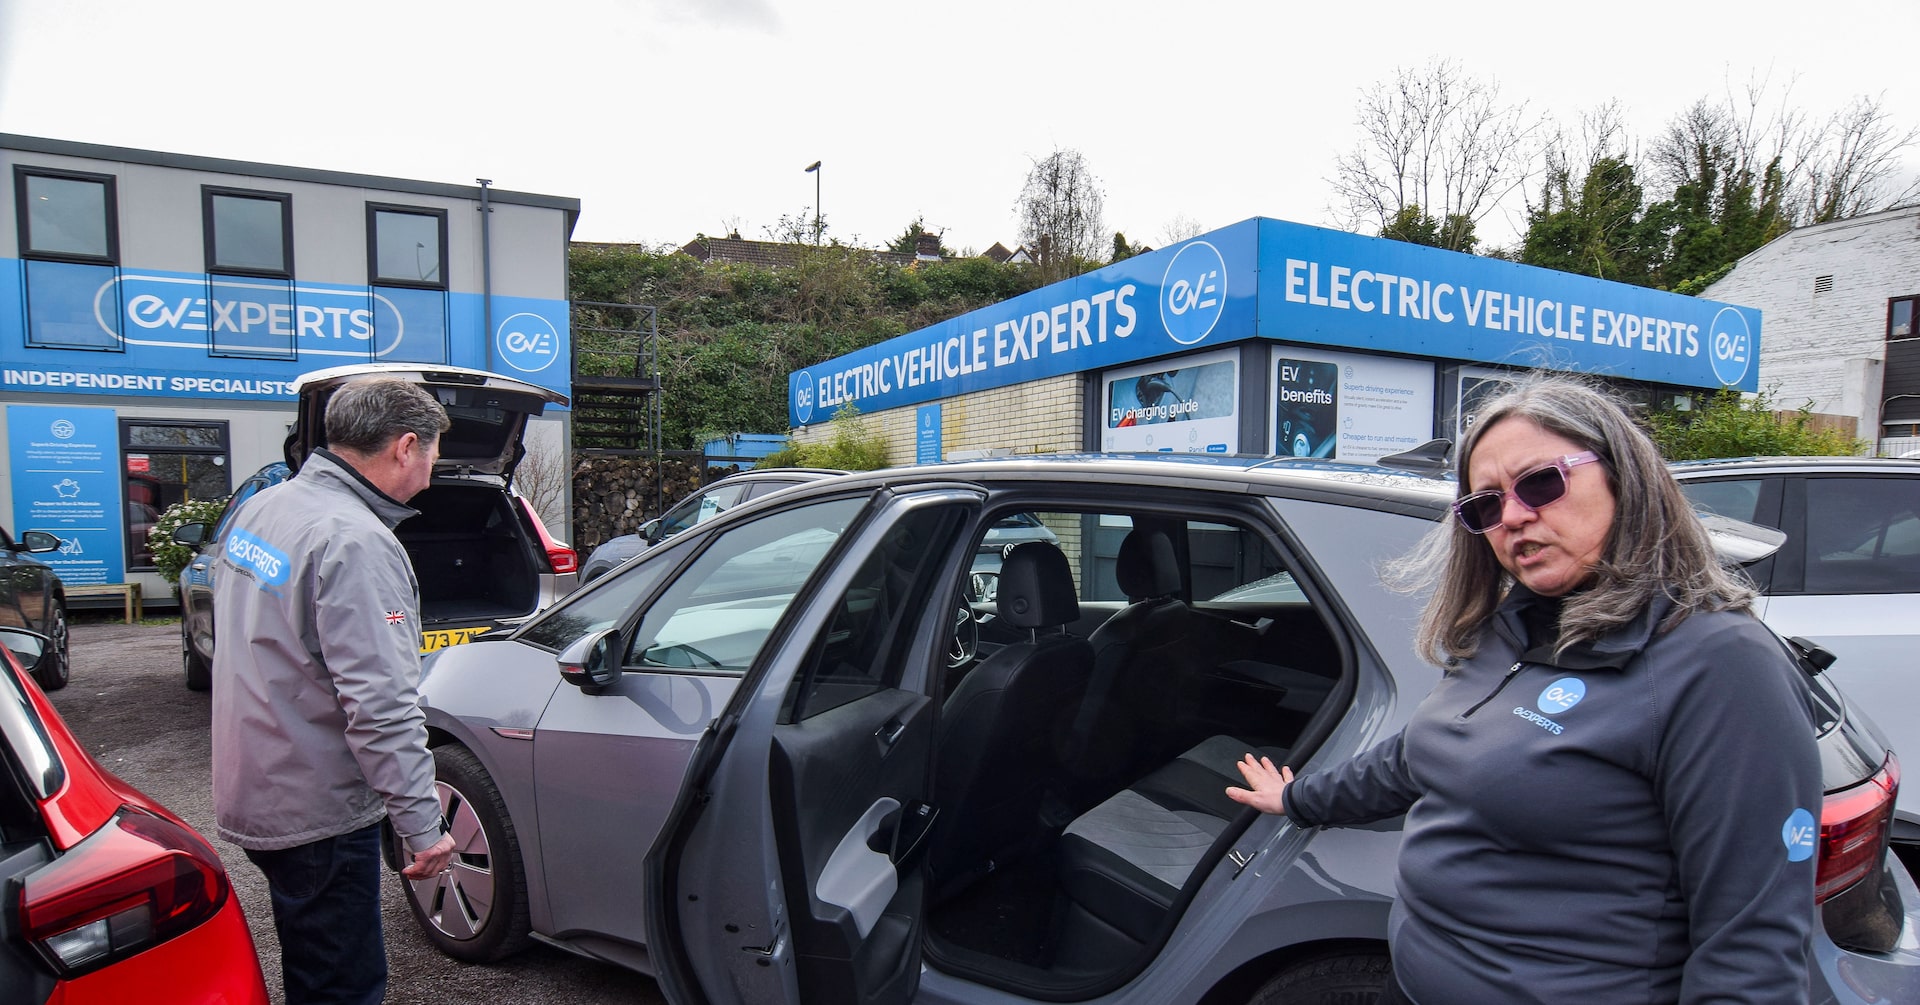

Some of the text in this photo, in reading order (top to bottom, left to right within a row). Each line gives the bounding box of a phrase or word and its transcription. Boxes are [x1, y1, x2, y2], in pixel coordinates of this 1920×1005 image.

[1285, 258, 1699, 357] ELECTRIC VEHICLE EXPERTS
[819, 283, 1137, 409] ELECTRIC VEHICLE EXPERTS
[3, 369, 298, 396] INDEPENDENT SPECIALISTS
[1281, 365, 1299, 382] EV
[1280, 386, 1333, 405] benefits
[1343, 382, 1364, 392] Superb
[1365, 384, 1385, 395] driving
[1112, 399, 1199, 421] EV charging guide
[1342, 432, 1367, 443] Cheaper
